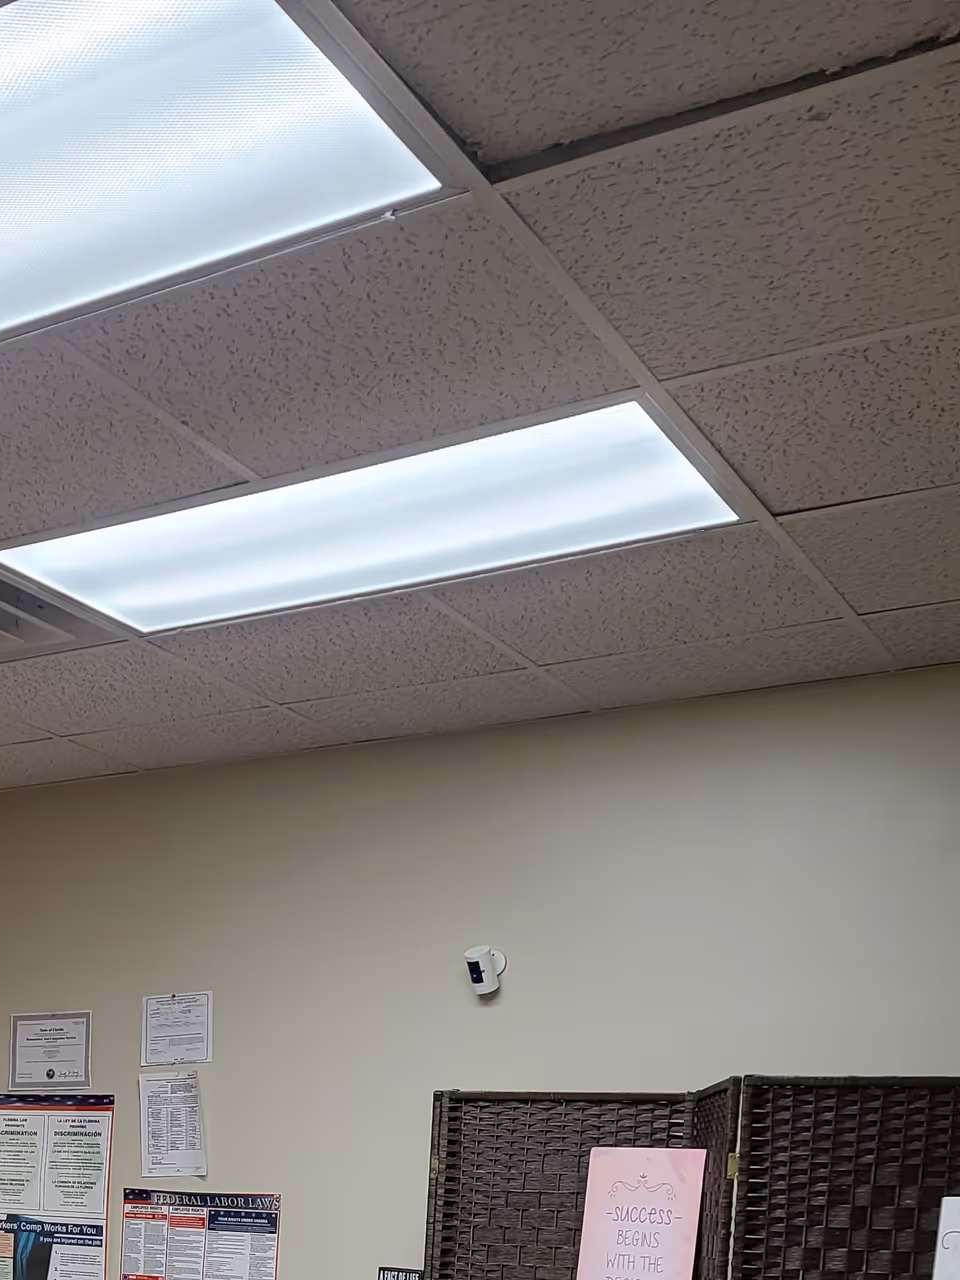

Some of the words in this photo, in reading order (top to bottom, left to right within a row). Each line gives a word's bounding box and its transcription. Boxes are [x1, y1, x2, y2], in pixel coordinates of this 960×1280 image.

[154, 1194, 203, 1206] FEDERAL
[207, 1196, 246, 1208] LABOR
[249, 1198, 280, 1210] LAWS
[21, 1222, 42, 1232] Comp
[43, 1224, 66, 1232] Works
[68, 1225, 82, 1233] For
[83, 1226, 96, 1234] You
[617, 1230, 660, 1248] BEGINS
[606, 1253, 636, 1271] WITH
[640, 1256, 663, 1273] THE
